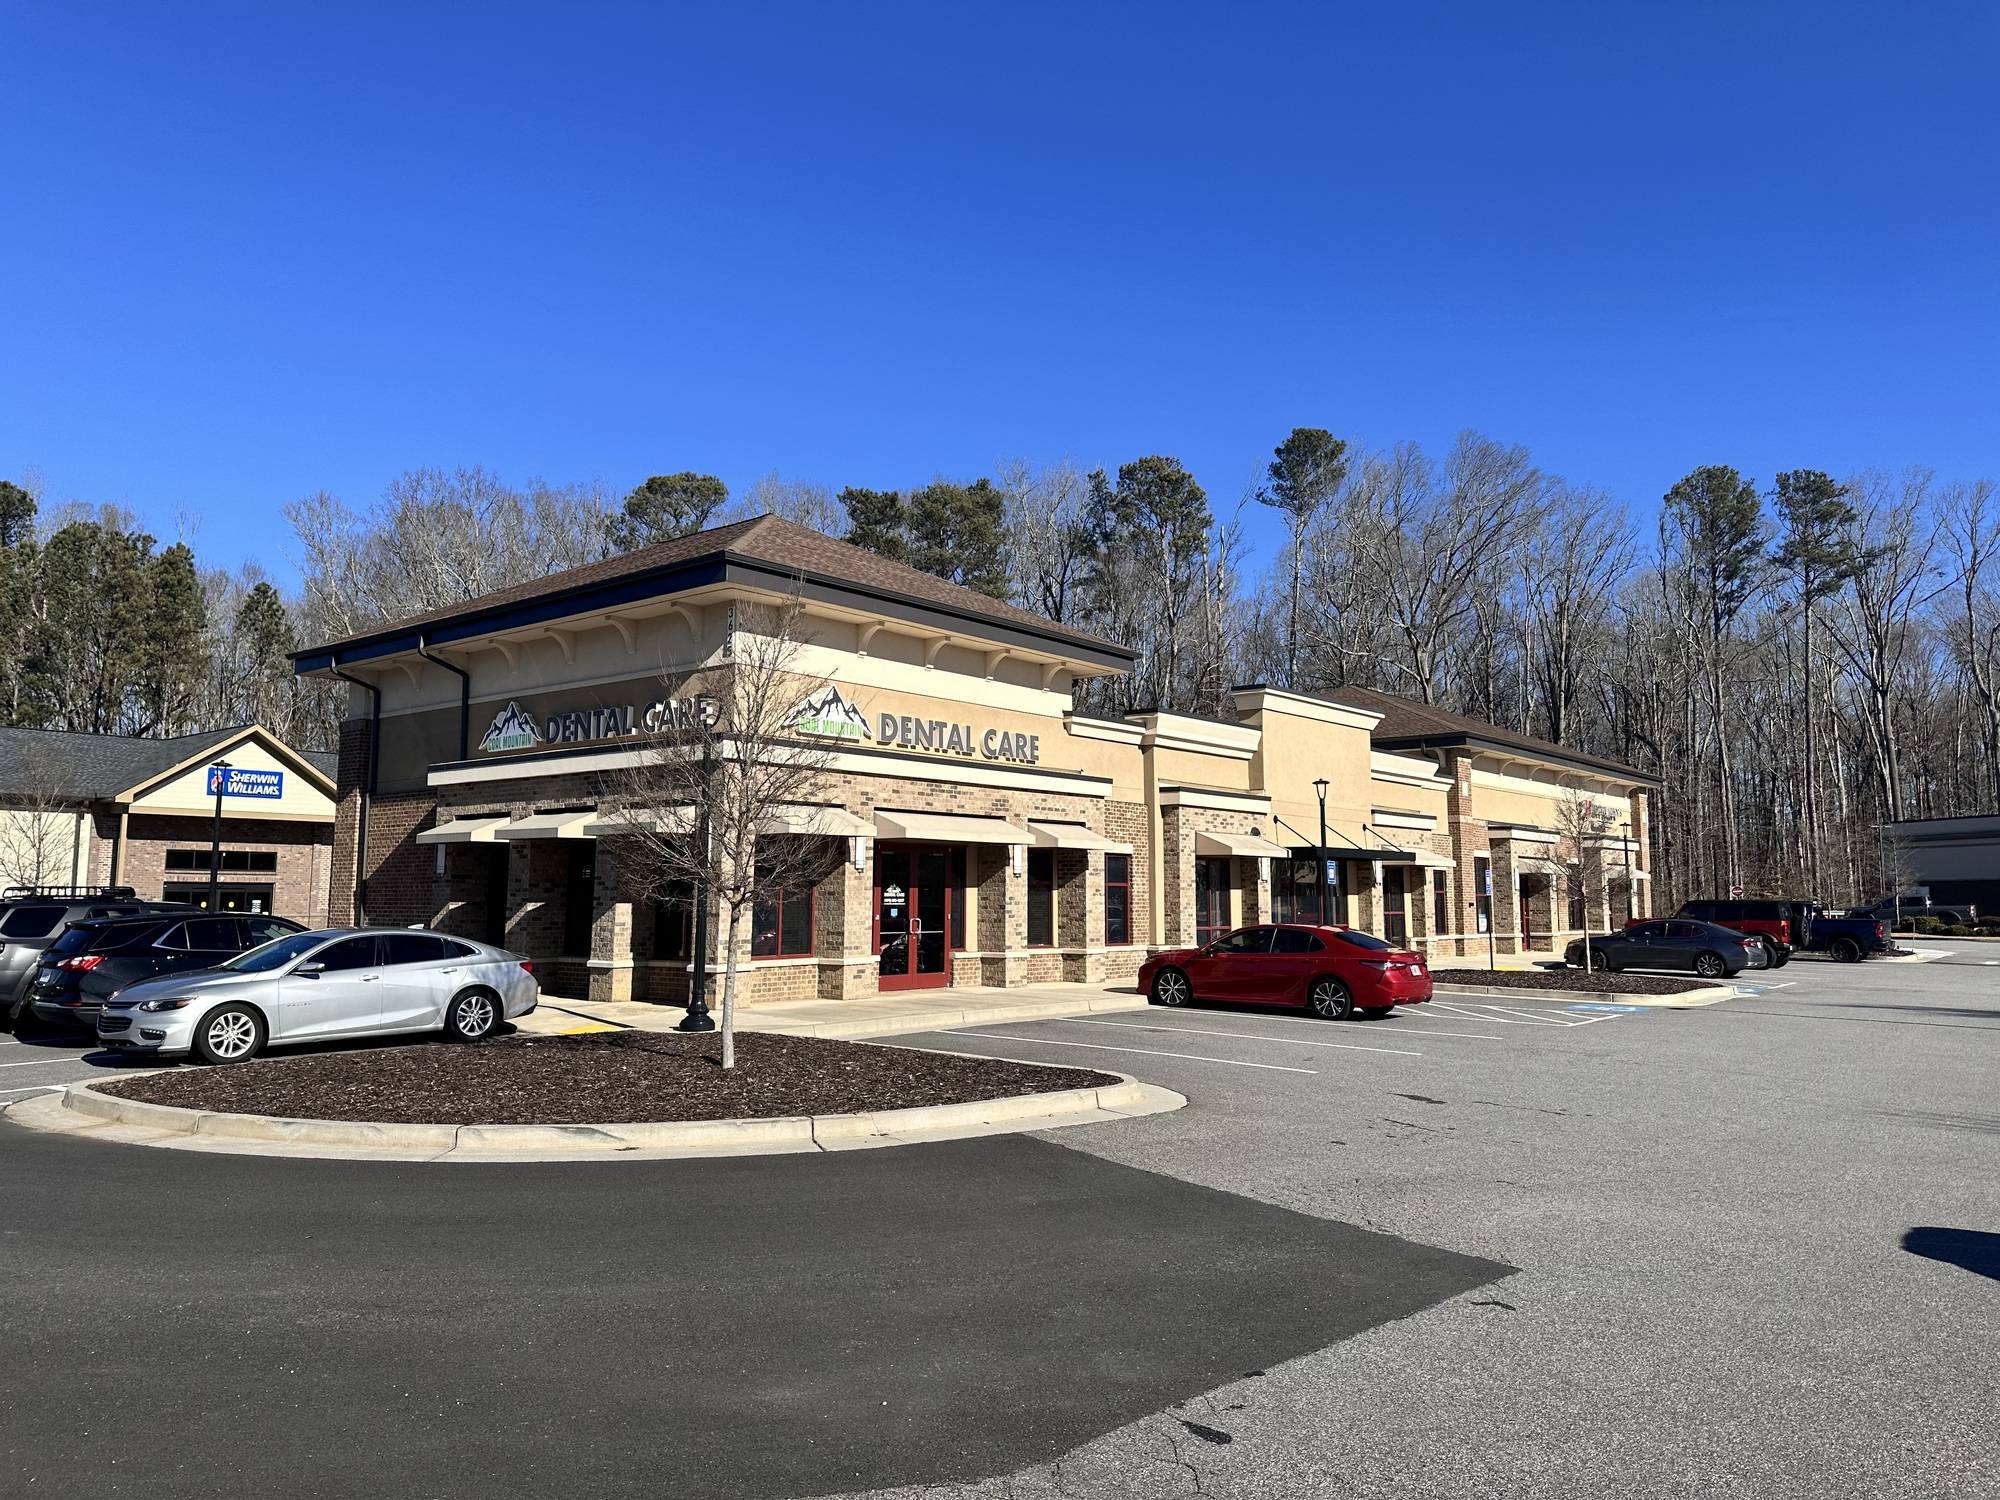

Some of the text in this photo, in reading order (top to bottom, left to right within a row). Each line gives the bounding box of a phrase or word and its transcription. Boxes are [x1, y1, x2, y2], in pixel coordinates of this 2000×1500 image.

[545, 694, 709, 744] DENTAL CARE
[503, 733, 532, 749] MOUNTAIN
[880, 712, 1039, 761] DENTAL CARE
[229, 771, 279, 784] SHERWIN
[227, 781, 280, 795] WILLIAMS
